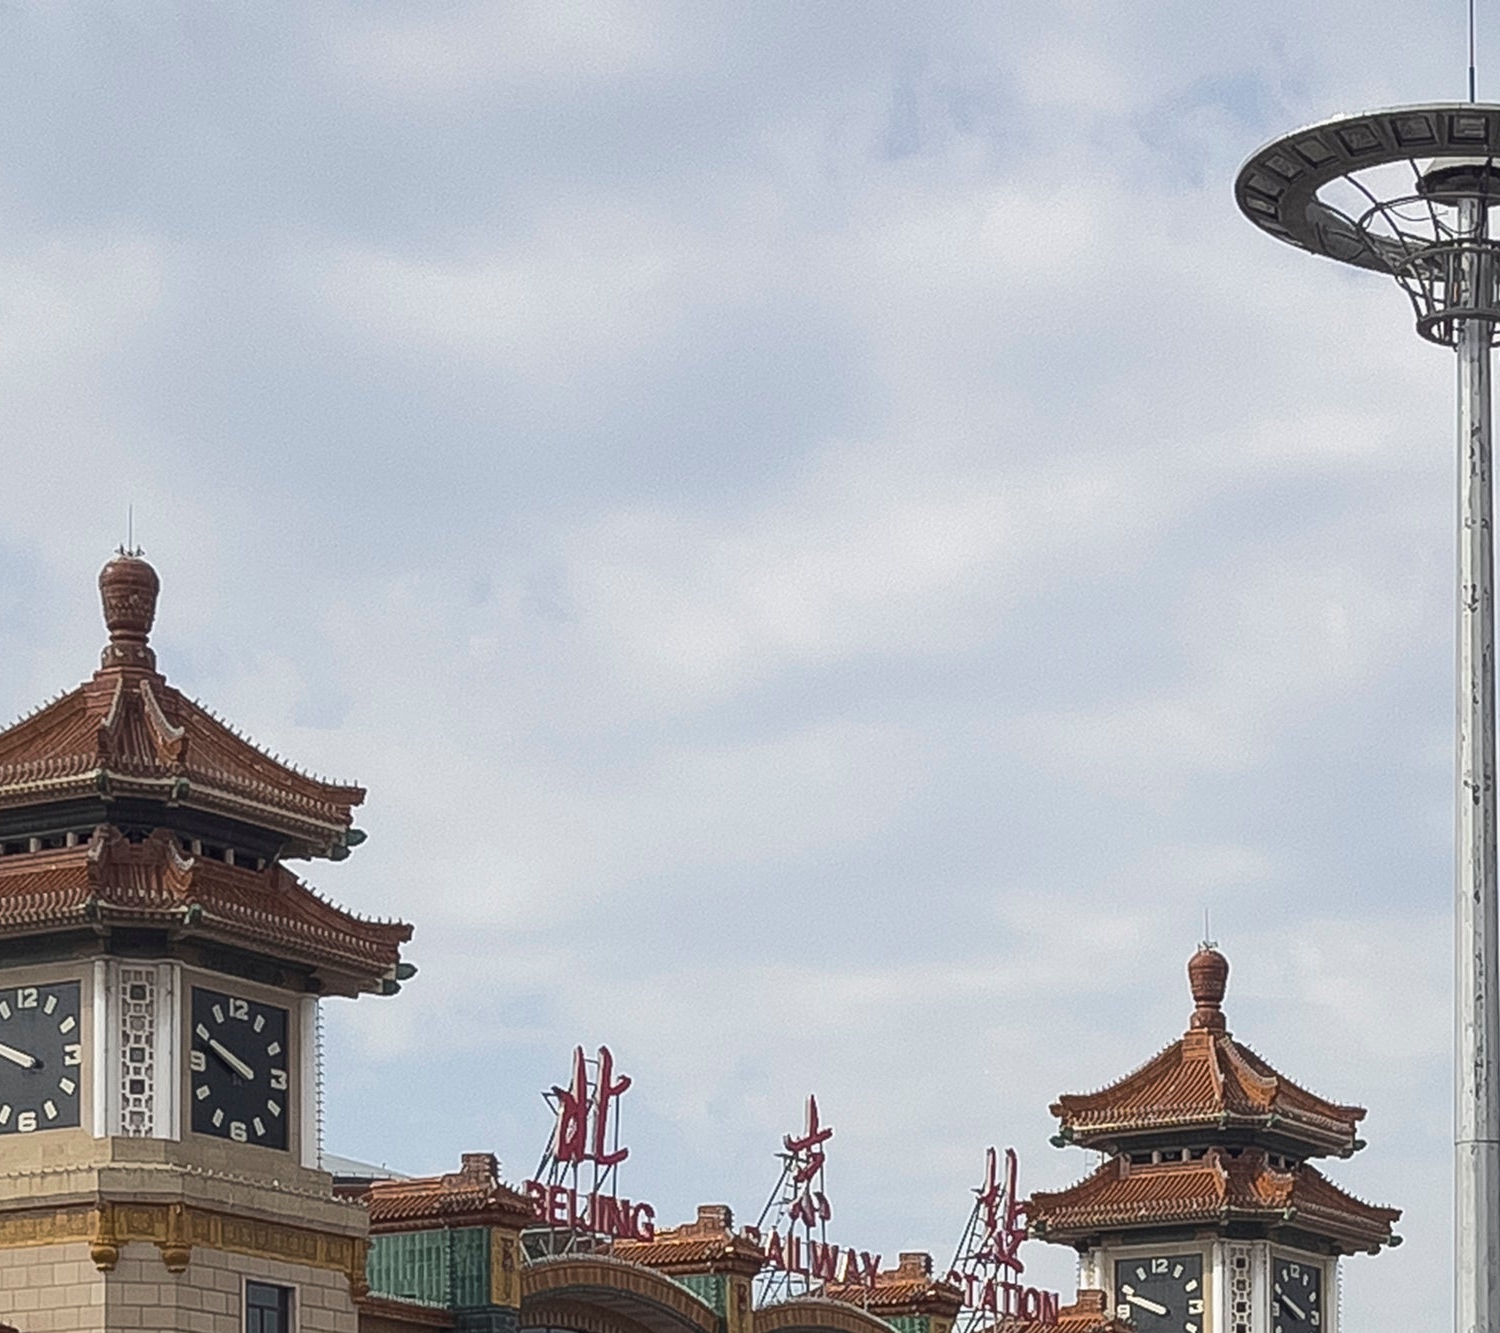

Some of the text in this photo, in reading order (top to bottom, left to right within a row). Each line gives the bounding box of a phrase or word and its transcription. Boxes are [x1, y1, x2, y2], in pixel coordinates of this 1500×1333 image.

[17, 988, 38, 1009] 12
[228, 998, 249, 1020] 12
[64, 1044, 81, 1066] 3
[270, 1068, 288, 1090] 3
[17, 1112, 37, 1132] 6
[523, 1180, 655, 1242] BEIJING
[1151, 1258, 1168, 1274] 12
